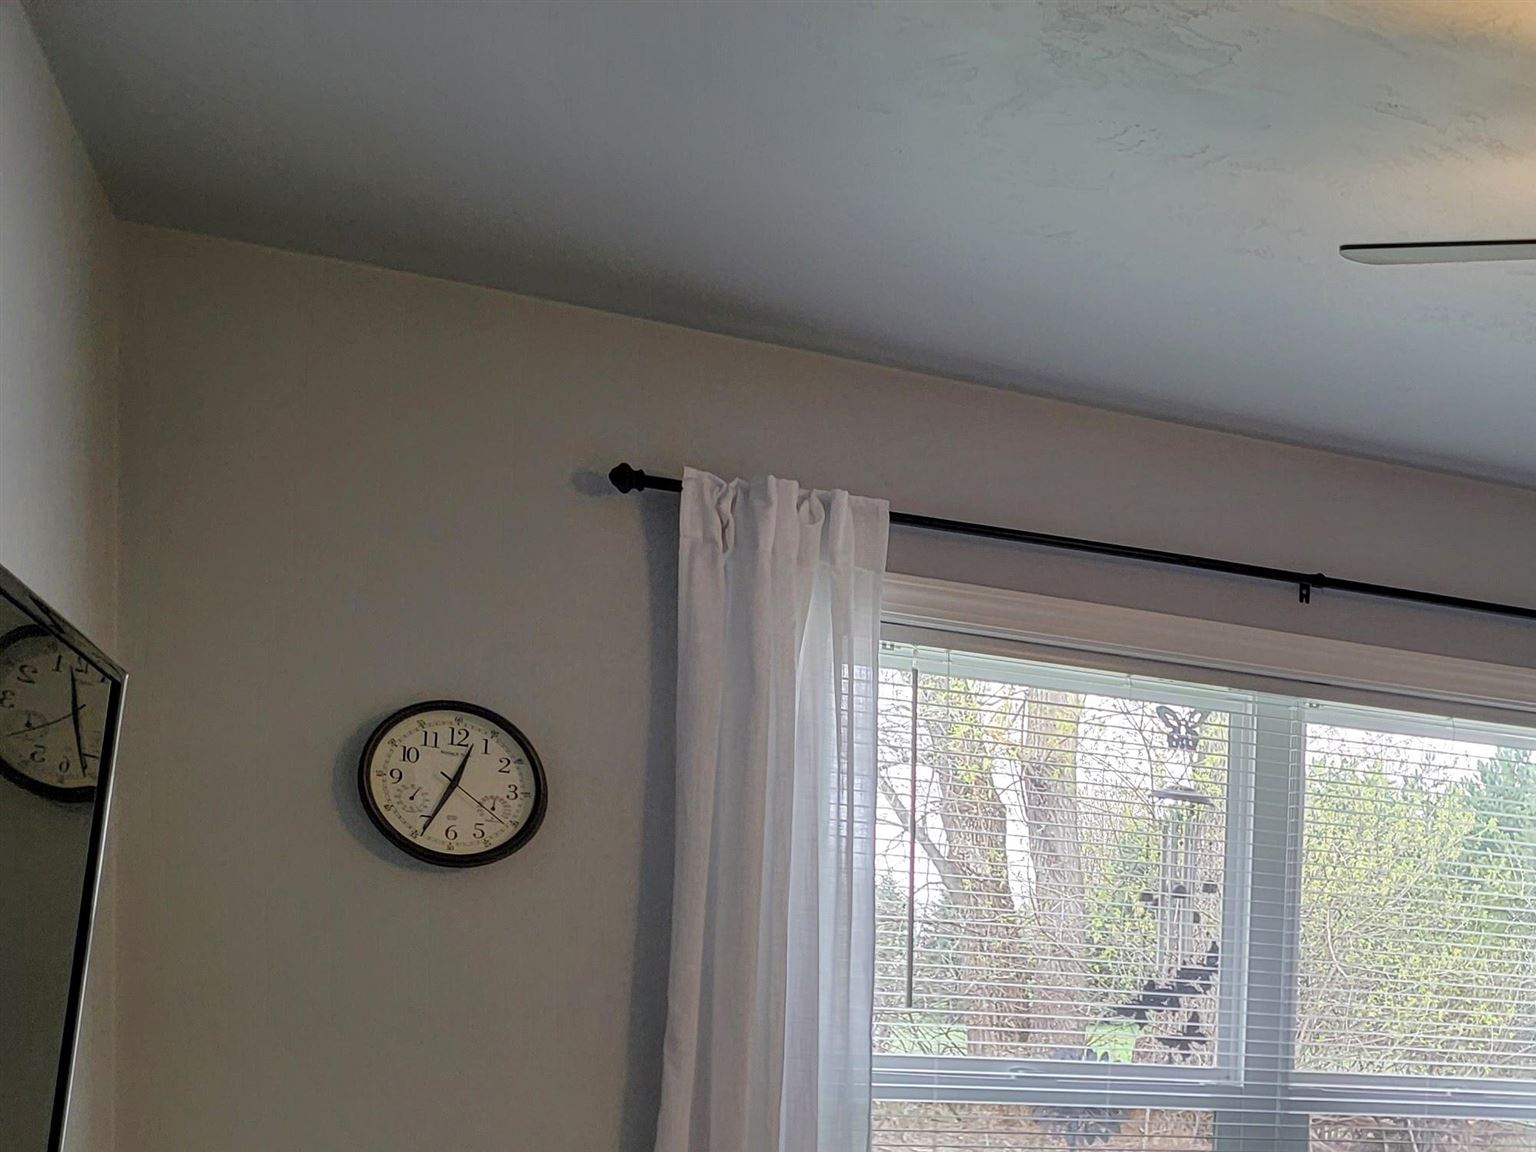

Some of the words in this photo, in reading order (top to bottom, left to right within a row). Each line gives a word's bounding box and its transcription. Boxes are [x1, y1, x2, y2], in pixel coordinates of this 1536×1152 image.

[421, 730, 441, 749] 11
[448, 727, 469, 747] 12
[401, 746, 420, 763] 10
[480, 739, 490, 755] 1
[498, 757, 511, 774] 2
[389, 768, 403, 784] 9
[506, 784, 518, 801] 3
[445, 825, 458, 841] 6
[473, 823, 485, 840] 5
